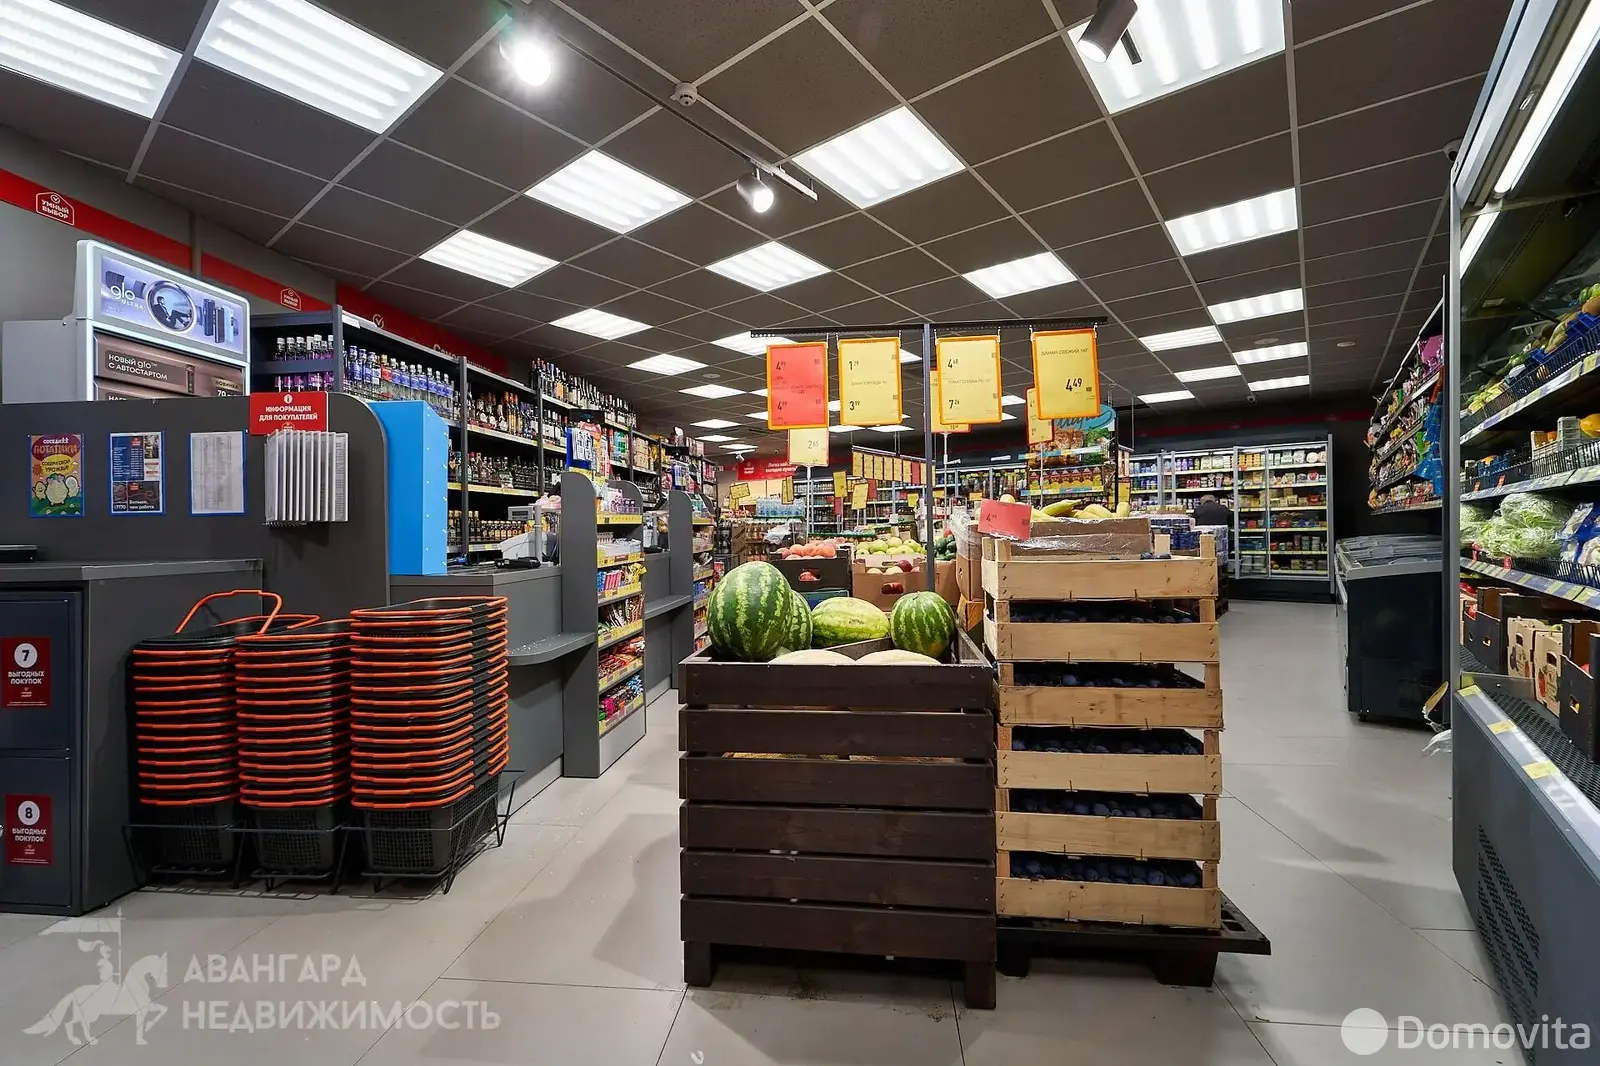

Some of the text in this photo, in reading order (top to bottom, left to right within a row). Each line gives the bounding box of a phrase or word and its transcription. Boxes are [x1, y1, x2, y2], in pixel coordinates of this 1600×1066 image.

[41, 199, 69, 214] УМНЫЙ
[42, 206, 69, 219] ВЫБОР
[110, 282, 136, 300] glo
[108, 354, 137, 366] НОВЫЙ
[116, 364, 168, 380] АВТОСТАРТОМ
[265, 405, 312, 413] ИНФОРМАЦИЯ
[259, 412, 318, 422] ДЛЯ ПОКУПАТЕЛЕЙ
[22, 650, 30, 661] 7
[7, 670, 45, 678] ВЫГОДНЫХ
[25, 807, 33, 819] 8
[12, 827, 47, 836] ВЫГОДНЫХ
